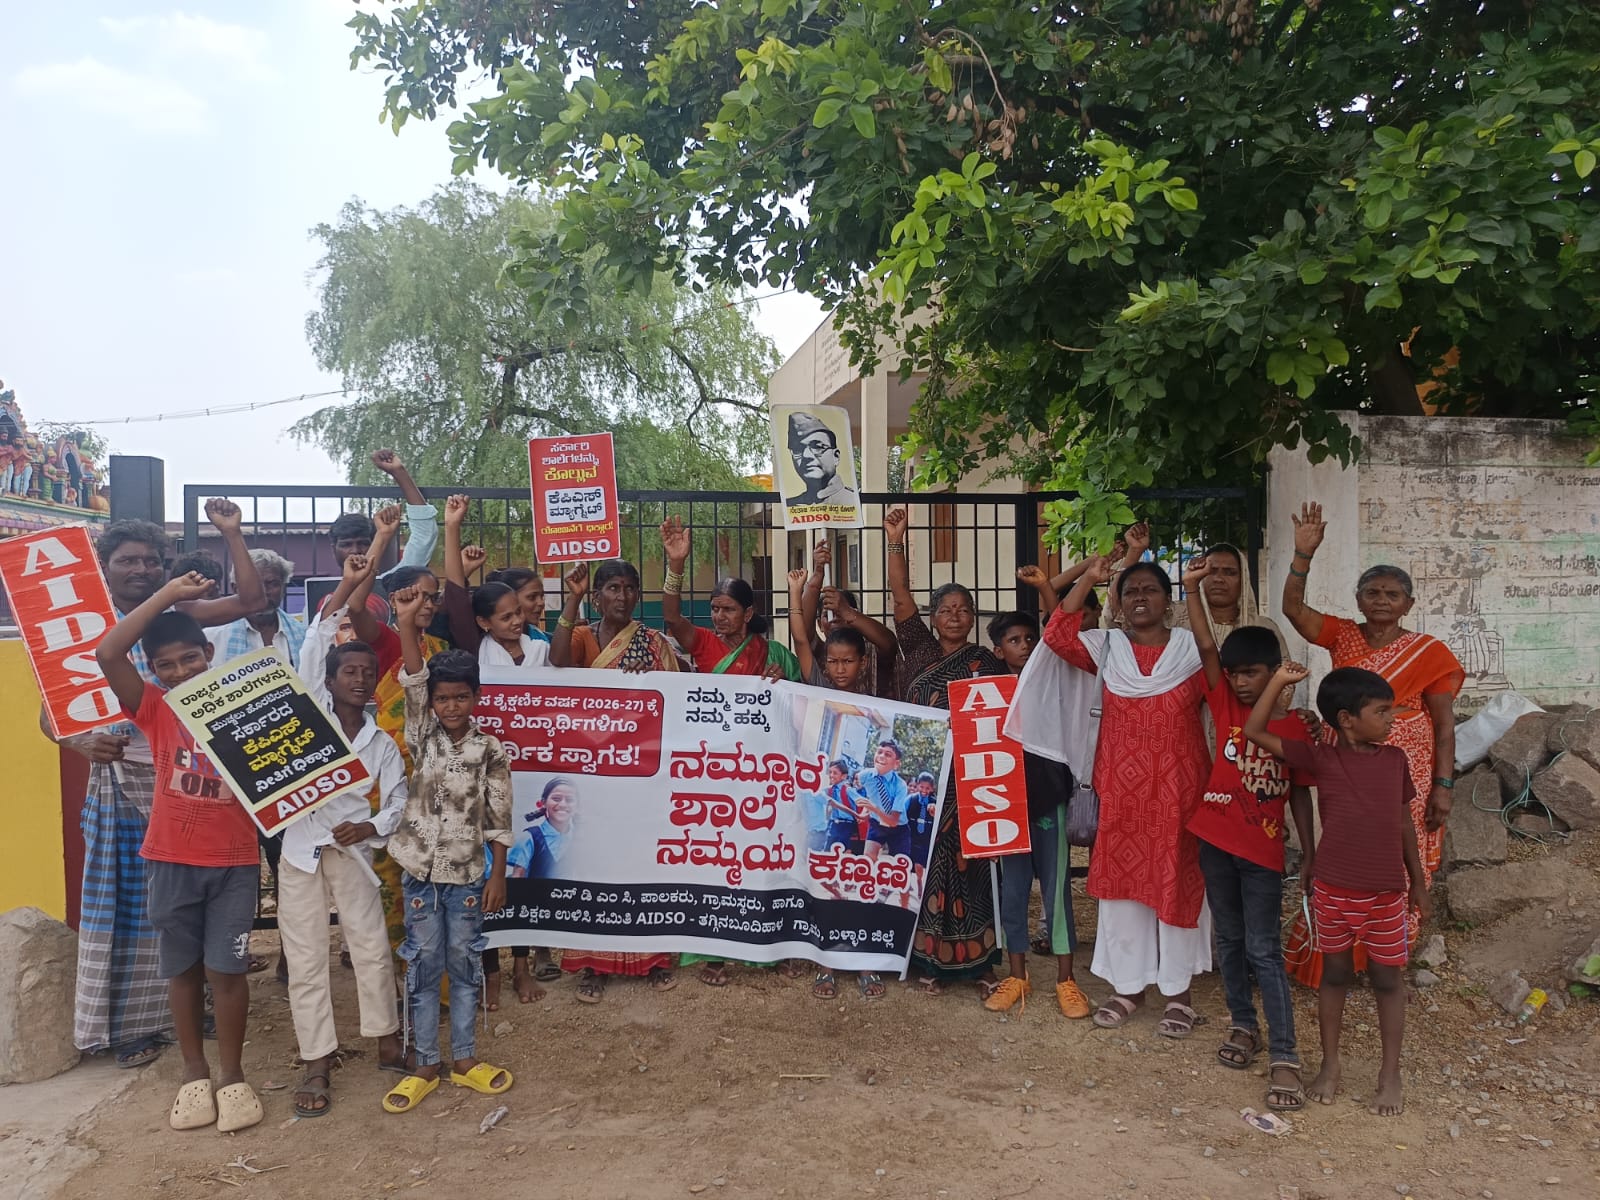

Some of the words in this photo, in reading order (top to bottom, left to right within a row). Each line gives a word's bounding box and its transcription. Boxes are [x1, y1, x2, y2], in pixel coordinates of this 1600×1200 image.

[550, 442, 590, 453] ಸರ್ಕಾರಿ
[549, 489, 601, 504] ಕೆಪಿಎಸ್
[549, 503, 602, 520] ಮ್ಯಾಗ್ನೆಟ್
[792, 513, 831, 524] AIDSO
[547, 539, 611, 556] AIDSO
[180, 681, 220, 706] ರಾಜ್ಯದ
[221, 657, 282, 686] 40,000ಕ್ಕೂ
[191, 696, 225, 719] ಅಧಿಕ
[225, 669, 292, 702] ಶಾಲೆಗಳನ್ನು
[494, 692, 542, 712] ಶೈಕ್ಷಣಿಕ
[545, 696, 580, 709] ವರ್ಷ
[583, 698, 644, 712] (2026-27)
[687, 687, 732, 712] ನಮ್ಮ
[734, 689, 772, 706] ಶಾಲೆ
[231, 701, 293, 741] ಸರ್ಕಾರದ
[510, 714, 637, 737] ವಿದ್ಯಾರ್ಥಿಗಳಿಗೂ
[685, 706, 731, 732] ನಮ್ಮ
[734, 708, 771, 733] ಹಕ್ಕು
[243, 716, 301, 755] ಕೆಪಿಎಸ್
[248, 728, 315, 771] ಮ್ಯಾಗ್ನೆಟ್
[560, 743, 640, 774] ಸ್ವಾಗತ!
[669, 740, 826, 802] ನಮ್ಮೂರ
[959, 682, 1020, 847] AIDSO
[255, 765, 294, 793] ನೀತಿಗೆ
[276, 768, 352, 820] AIDSO
[668, 784, 778, 831] ಶಾಲೆ
[656, 829, 796, 886] ನಮ್ಮಯ
[808, 845, 910, 899] ಕಣ್ಮಣಿ
[550, 887, 577, 899] ಎಸ್
[580, 889, 593, 901] ಡಿ
[596, 892, 618, 903] ಎಂ
[640, 890, 698, 906] ಪಾಲಕರು,
[702, 893, 765, 916] ಗ್ರಾಮಸ್ಥರು,
[772, 896, 804, 910] ಹಾಗೂ
[519, 904, 551, 924] ಶಿಕ್ಷಣ
[555, 909, 591, 923] ಉಳಿಸಿ
[595, 911, 632, 924] ಸಮಿತಿ
[636, 911, 686, 925] AIDSO
[829, 929, 867, 947] ಬಳ್ಳಾರಿ
[871, 930, 895, 948] ಜಿಲ್ಲೆ
